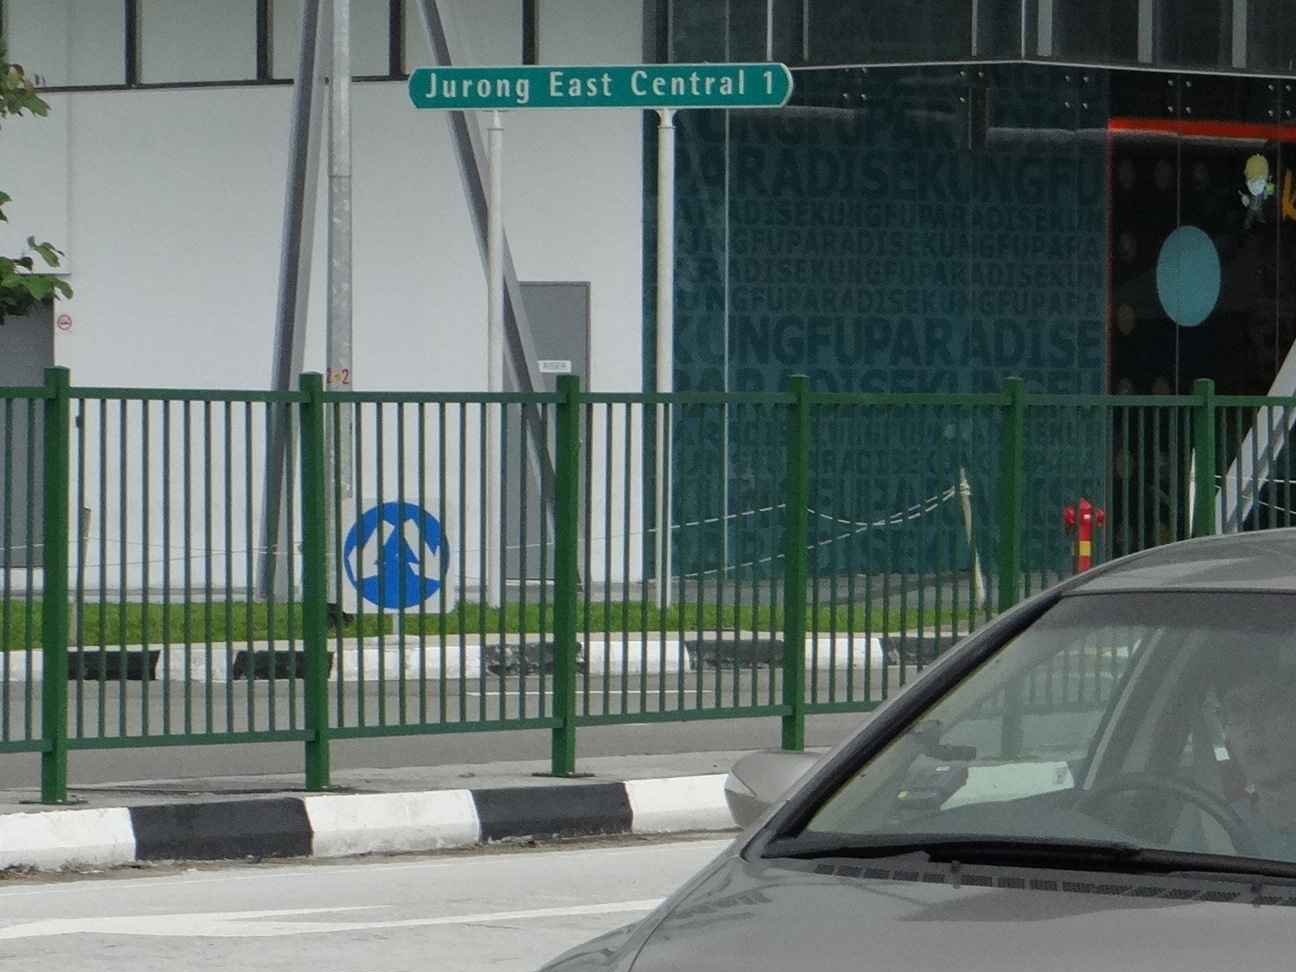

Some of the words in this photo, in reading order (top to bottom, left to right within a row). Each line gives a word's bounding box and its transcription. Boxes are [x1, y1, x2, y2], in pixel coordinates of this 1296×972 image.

[425, 72, 530, 104] Jurong
[550, 71, 612, 97] East
[631, 69, 745, 96] Central
[763, 71, 773, 95] 1
